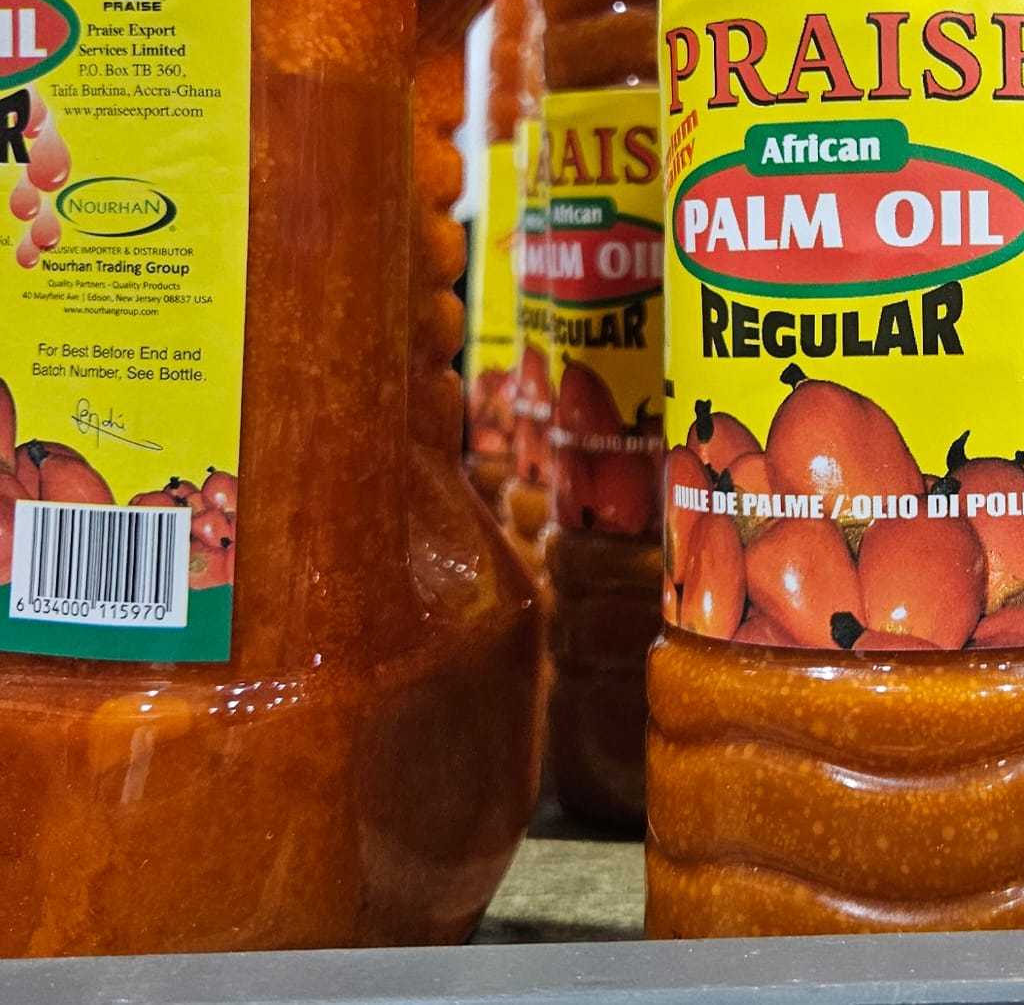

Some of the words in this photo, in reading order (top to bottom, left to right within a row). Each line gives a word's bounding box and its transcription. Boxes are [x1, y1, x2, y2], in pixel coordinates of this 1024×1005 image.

[103, 1, 162, 12] PRAISE
[87, 24, 125, 37] Praise
[129, 24, 177, 39] Export
[79, 44, 128, 57] Services
[132, 43, 187, 57] Limited
[106, 64, 129, 77] Box
[133, 64, 152, 76] TB
[51, 84, 79, 97] Taifa
[82, 84, 131, 99] Burkina,
[134, 85, 222, 99] Accra-Ghana
[64, 104, 204, 120] www.praiseexport.com
[761, 134, 881, 165] African
[552, 203, 603, 225] African
[683, 193, 843, 254] PALM
[875, 189, 1005, 247] OIL
[81, 246, 122, 256] IMPORTER
[124, 247, 131, 256] &
[134, 247, 194, 257] DISTRIBUTOR
[42, 260, 93, 273] Nourhan
[96, 260, 142, 276] Trading
[146, 261, 190, 276] Group
[48, 279, 73, 289] Quality
[76, 279, 105, 289] Partners
[113, 280, 140, 291] Quality
[143, 281, 180, 291] Products
[22, 291, 33, 300] 40
[116, 294, 134, 303] New
[135, 295, 161, 305] Jersey
[163, 295, 191, 305] 08837
[194, 296, 213, 305] USA
[63, 306, 159, 317] www.nourhangroup.com
[701, 280, 965, 359] REGULAR
[38, 343, 57, 356] For
[62, 344, 89, 358] Best
[93, 345, 135, 359] Before
[140, 347, 168, 360] End
[173, 347, 202, 361] and
[32, 363, 66, 378] Batch
[70, 365, 121, 380] Number,
[127, 367, 154, 381] See
[159, 368, 207, 382] Bottle.
[674, 484, 710, 512] HUILE
[712, 491, 738, 516] DE
[741, 492, 825, 520] PALME
[853, 492, 919, 520] OLIO
[927, 491, 960, 518] DI
[16, 599, 25, 612] 6
